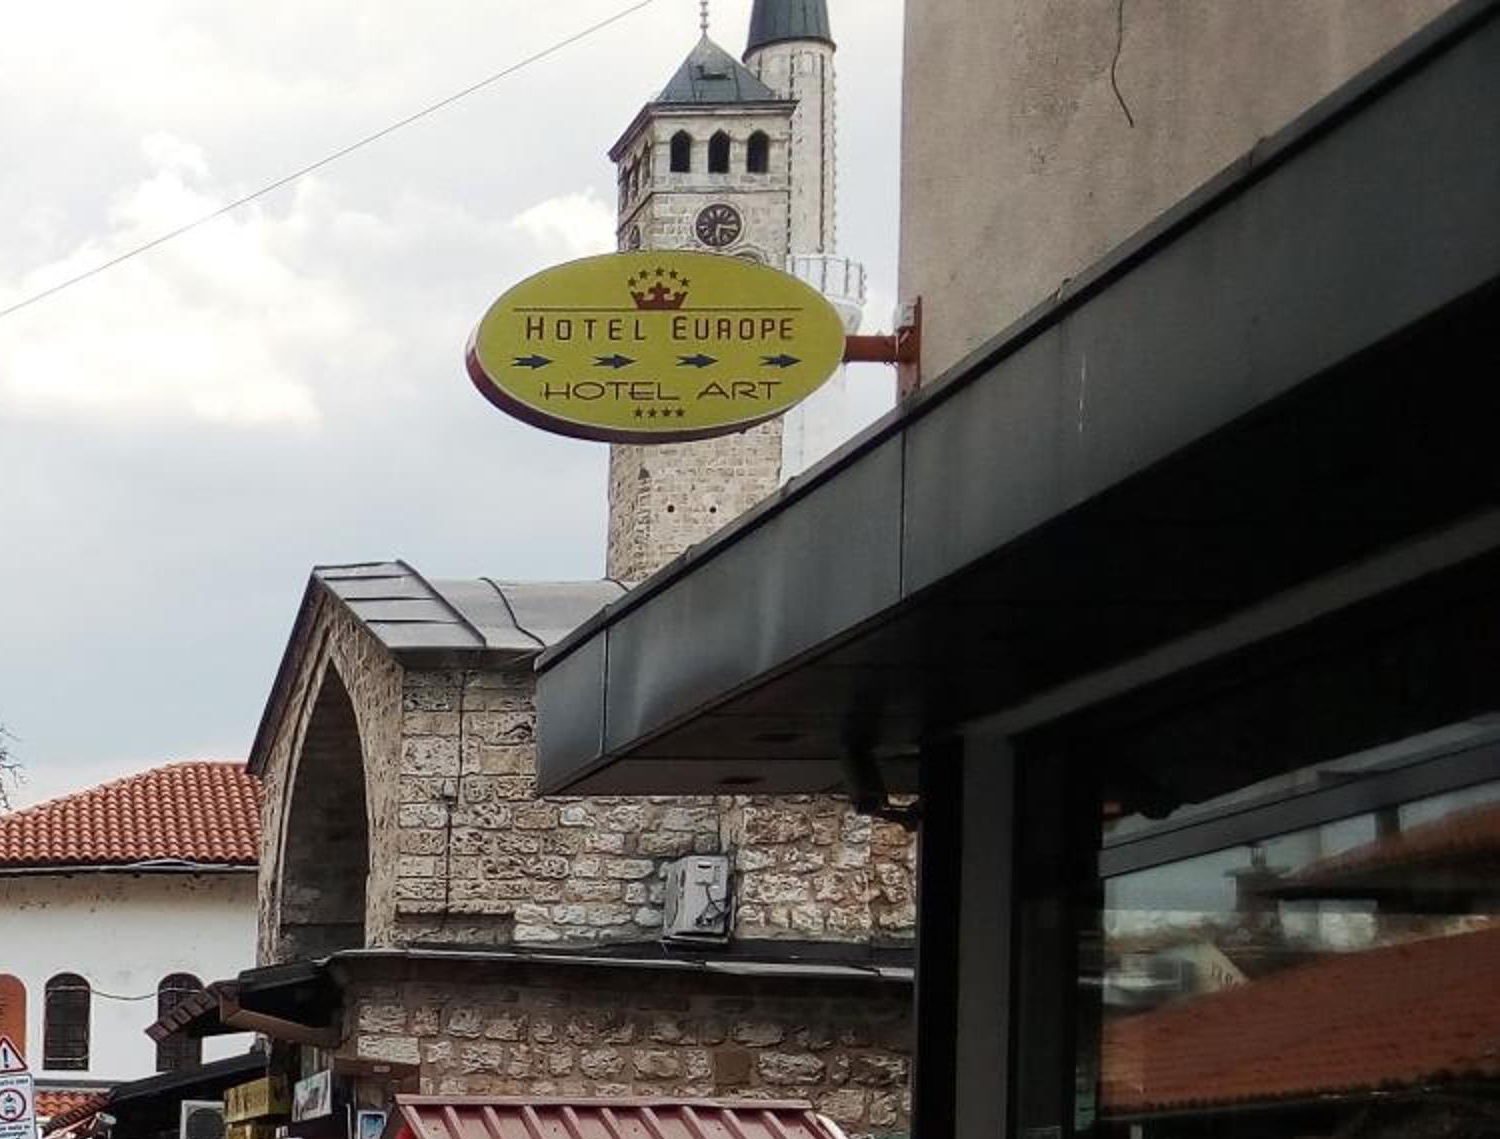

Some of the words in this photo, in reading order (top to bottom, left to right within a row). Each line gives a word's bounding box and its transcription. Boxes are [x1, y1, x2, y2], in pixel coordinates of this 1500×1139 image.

[526, 316, 646, 341] HOTEL
[672, 316, 794, 341] EUROPE
[543, 381, 680, 400] HOTEL
[697, 381, 782, 400] ART
